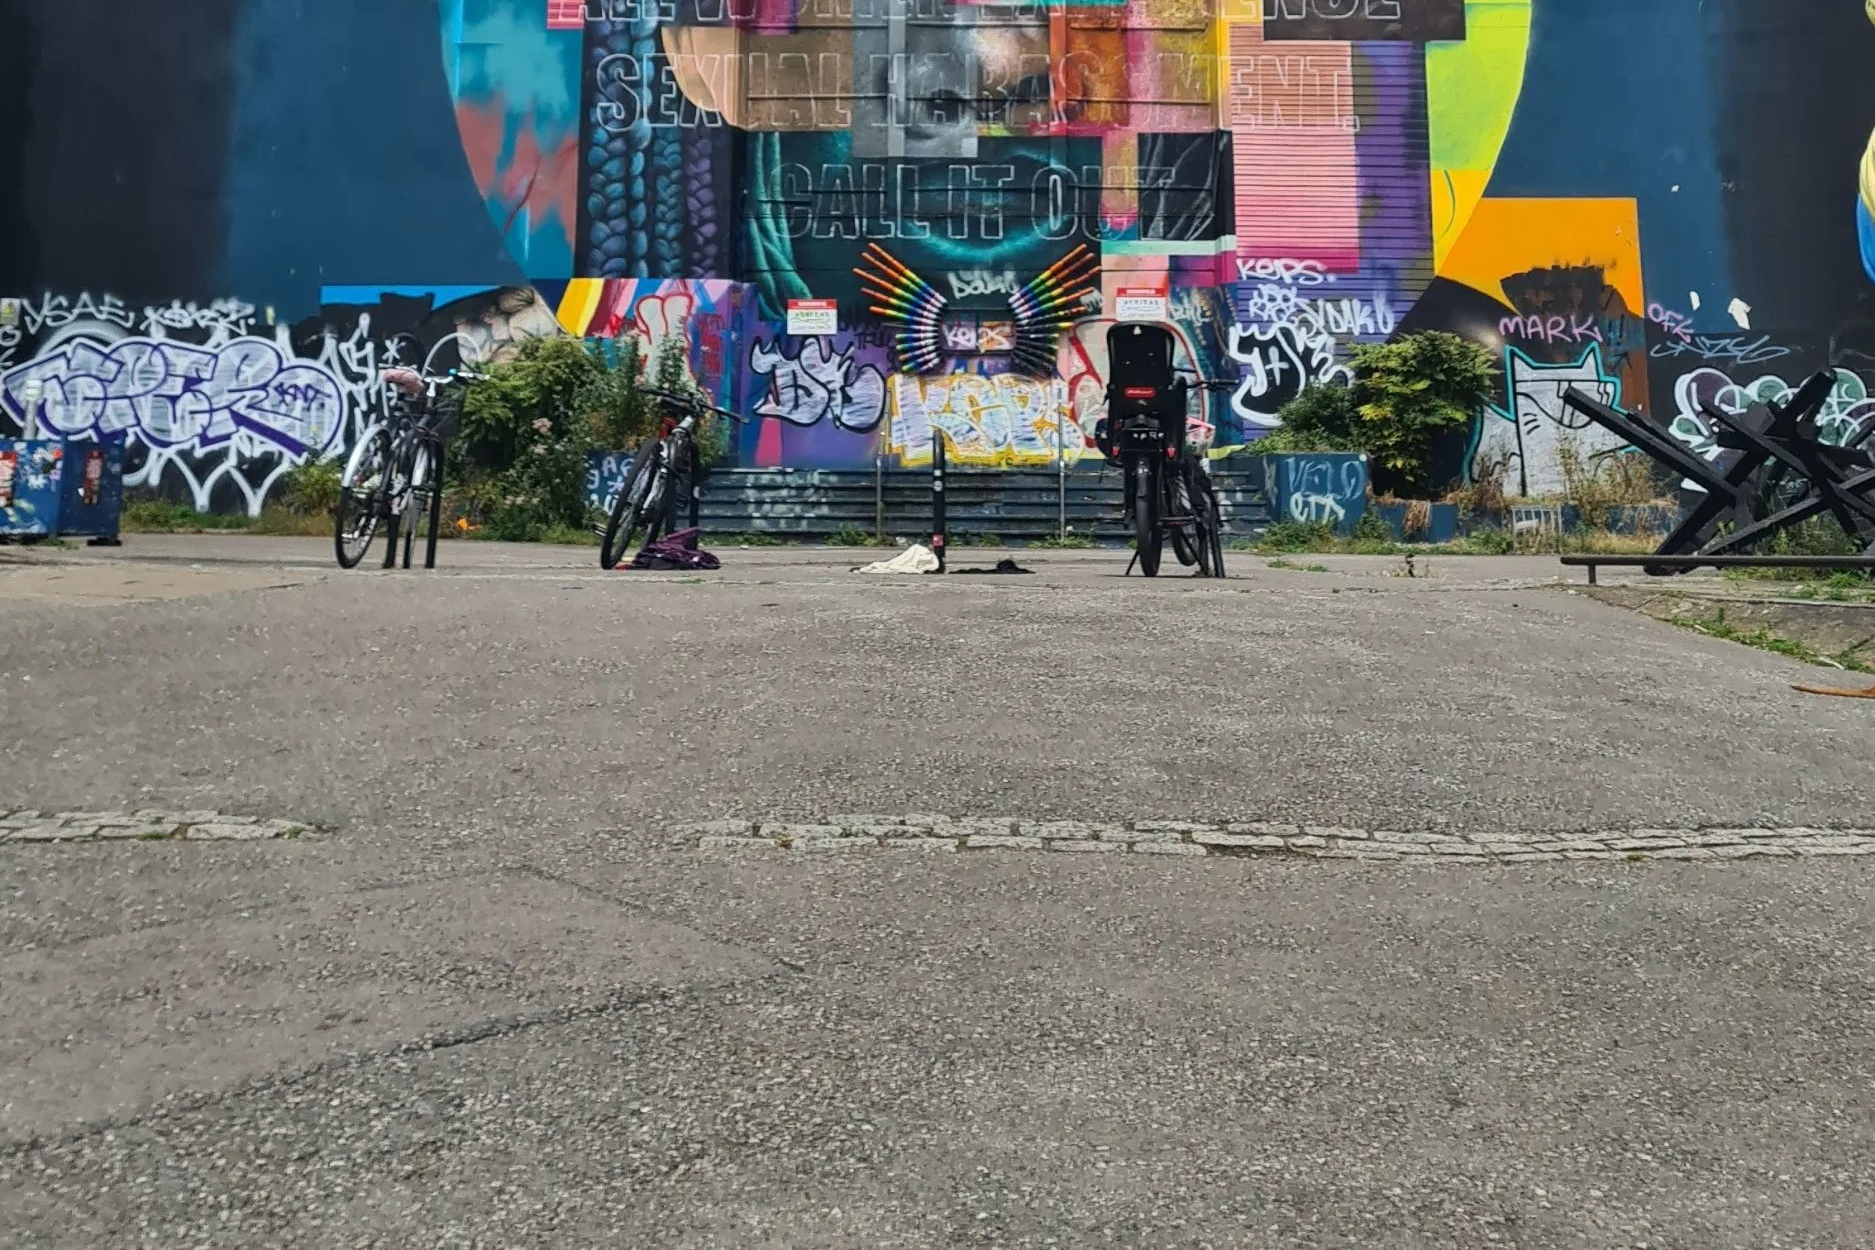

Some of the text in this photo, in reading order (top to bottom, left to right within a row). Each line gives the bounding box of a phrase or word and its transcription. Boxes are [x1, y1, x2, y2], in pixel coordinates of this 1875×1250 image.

[595, 51, 853, 133] SEXUAL
[769, 162, 1176, 241] CALL IT OUT
[1499, 313, 1603, 344] MARK
[1648, 302, 1695, 344] OFK
